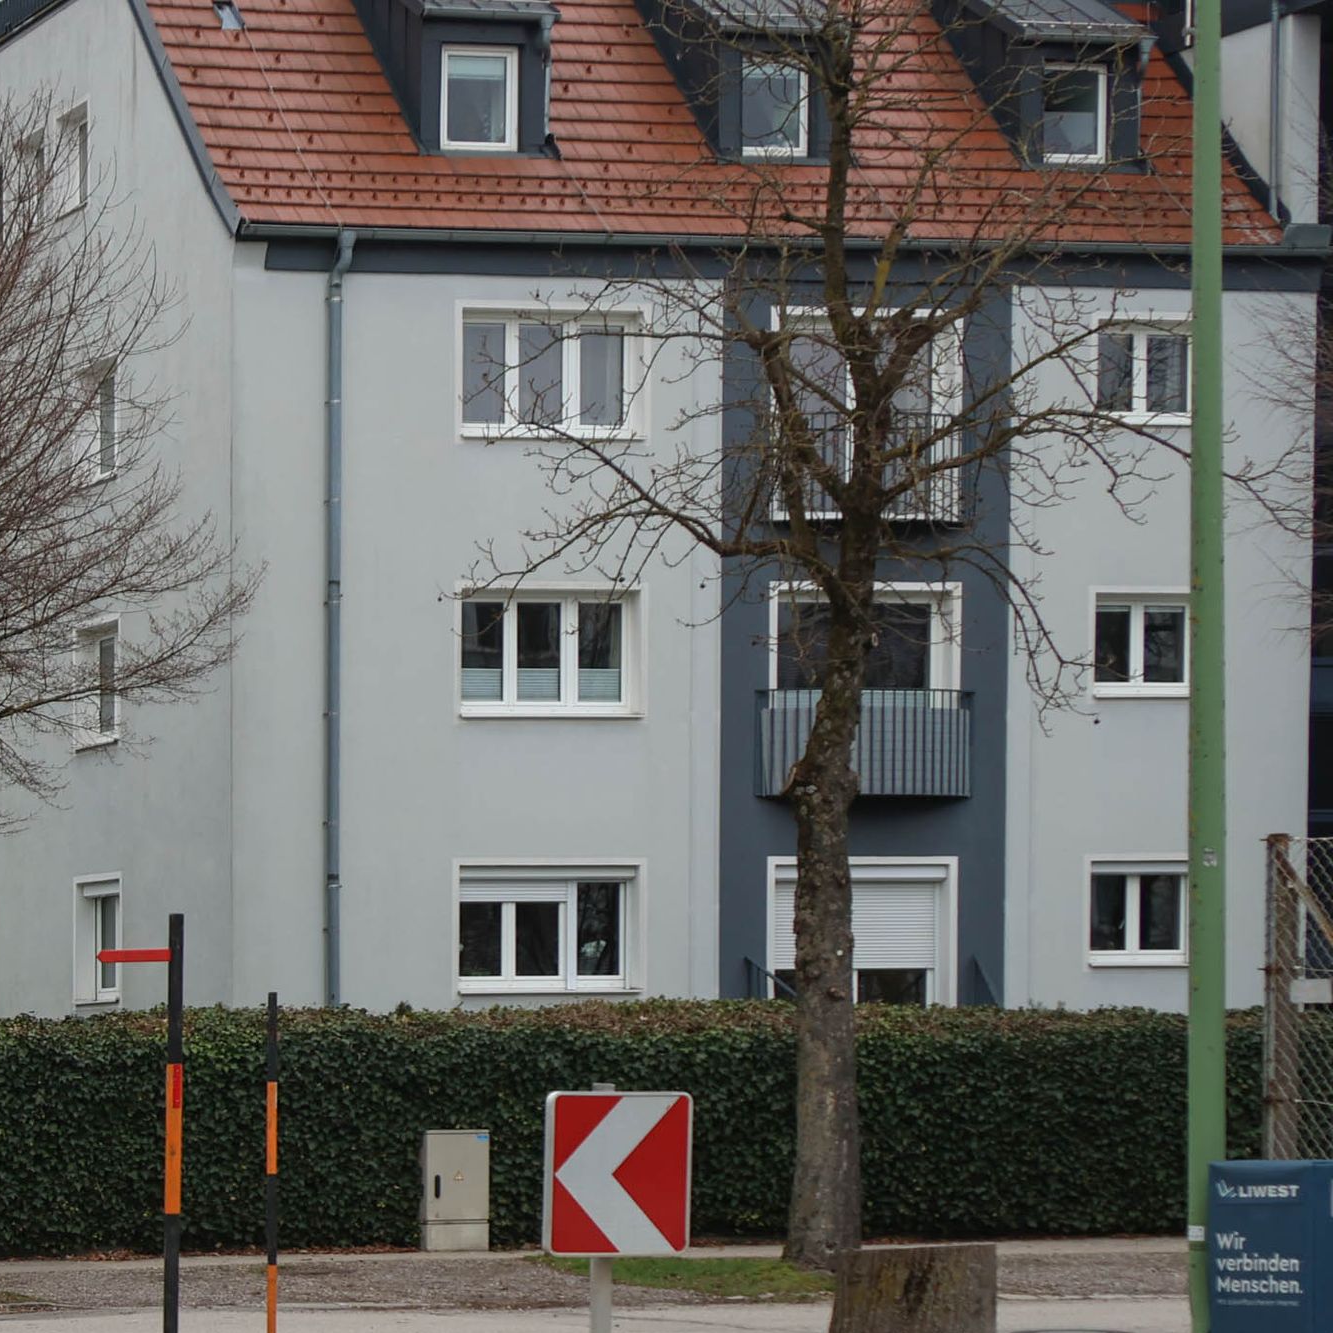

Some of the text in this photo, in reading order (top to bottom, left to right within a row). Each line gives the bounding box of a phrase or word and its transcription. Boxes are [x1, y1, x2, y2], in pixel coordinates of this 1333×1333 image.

[1237, 1184, 1300, 1198] LIWEST
[1216, 1231, 1246, 1250] Wir
[1216, 1253, 1300, 1272] verbinden
[1217, 1274, 1303, 1294] Menschen.
